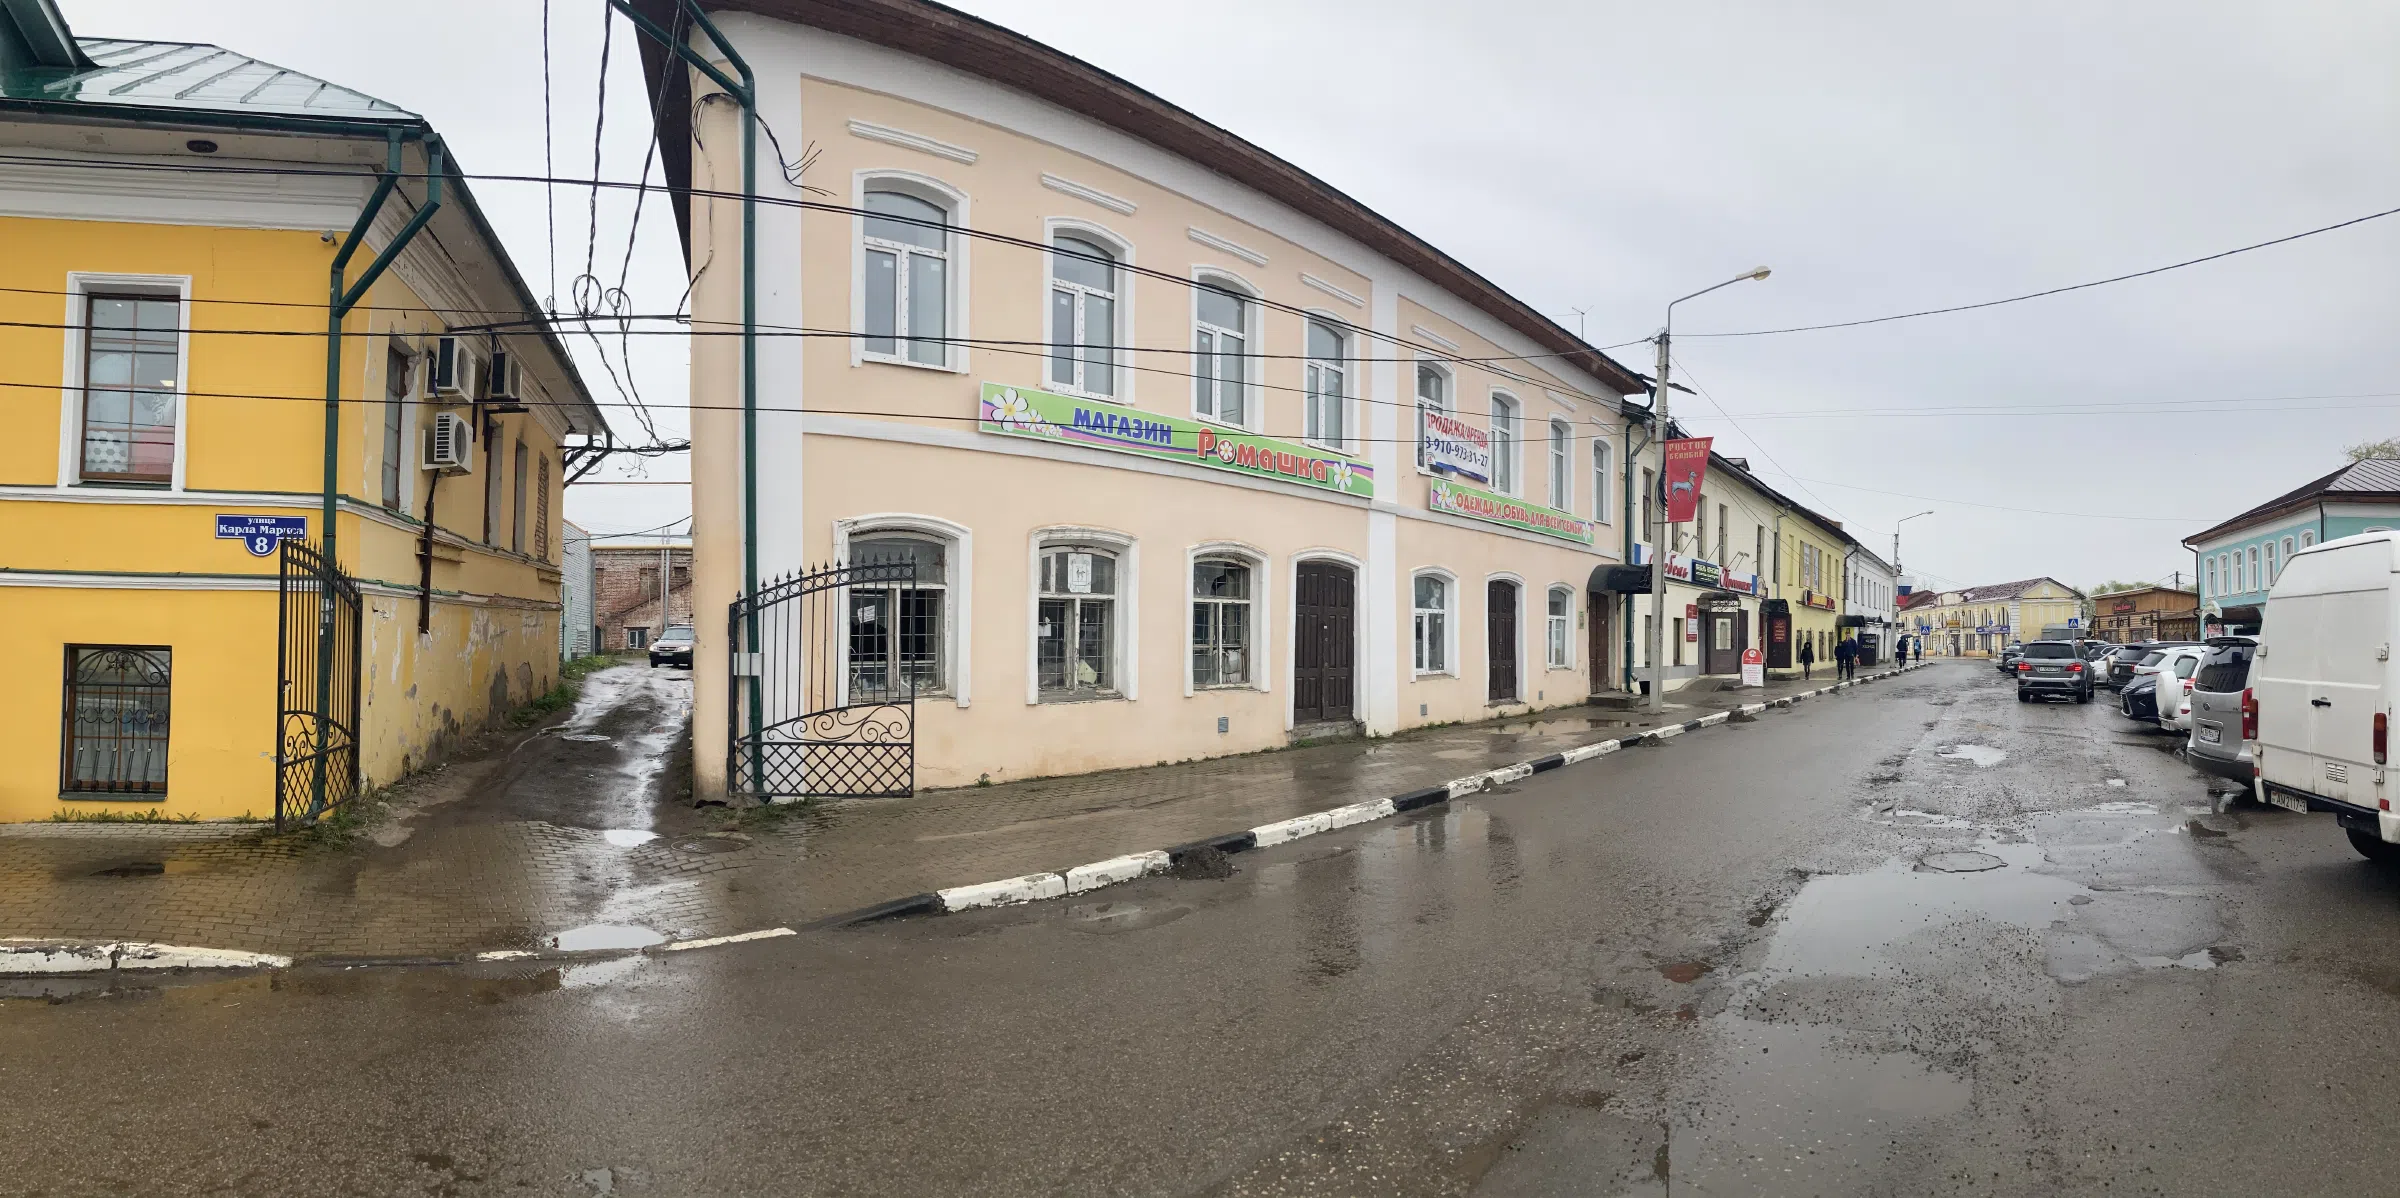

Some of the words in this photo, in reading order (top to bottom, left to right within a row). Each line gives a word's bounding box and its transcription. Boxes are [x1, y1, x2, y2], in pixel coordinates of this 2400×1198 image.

[1073, 407, 1172, 445] МАГАЗИН
[1197, 427, 1328, 483] Ромашка
[1668, 440, 1707, 452] РОСТОВ
[1456, 491, 1494, 516] ОДЕЖДА
[1495, 500, 1502, 517] И
[1503, 503, 1529, 523] ОБУВЬ
[1530, 511, 1545, 527] ДЛЯ
[1545, 514, 1562, 530] ВСЕЙ
[1562, 519, 1583, 536] СЕМЬИ
[247, 518, 276, 526] улица
[219, 524, 256, 536] Карла
[259, 525, 304, 537] Маркса
[254, 536, 268, 553] 8
